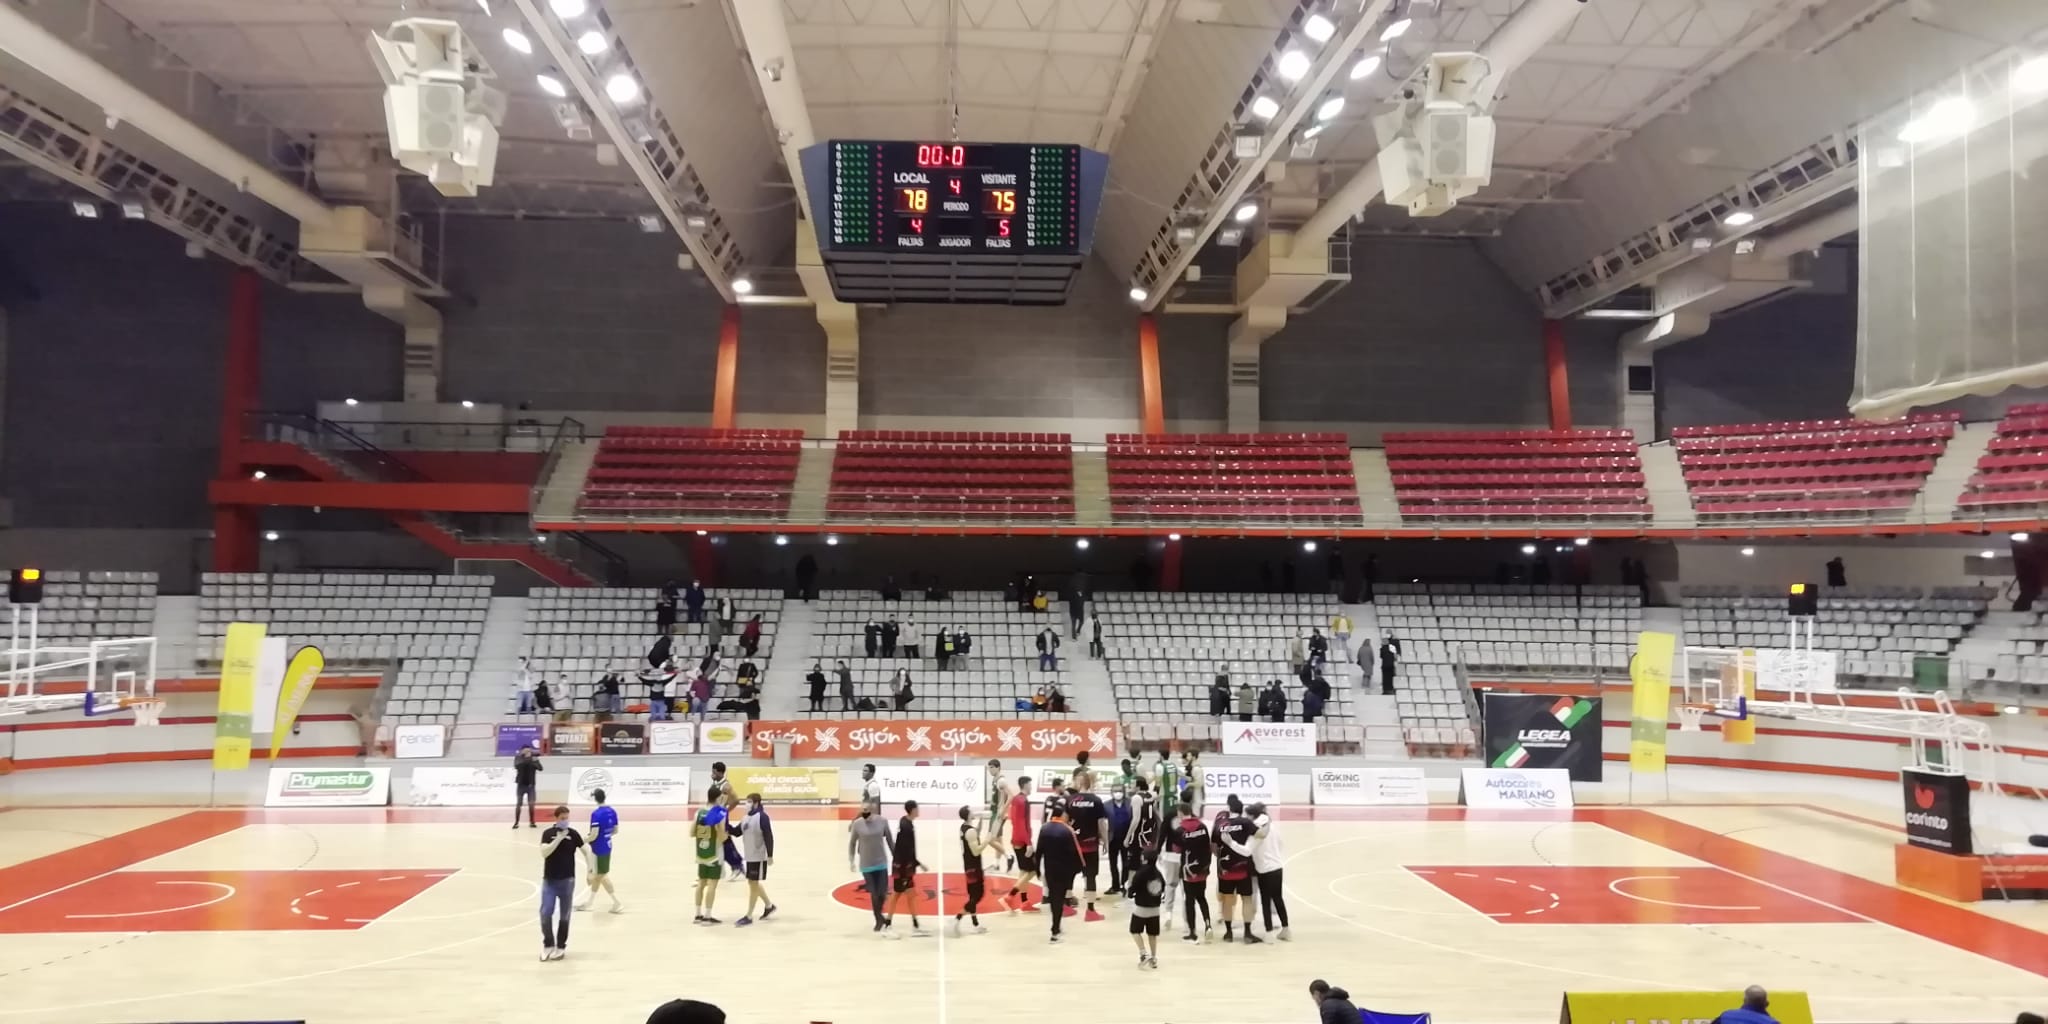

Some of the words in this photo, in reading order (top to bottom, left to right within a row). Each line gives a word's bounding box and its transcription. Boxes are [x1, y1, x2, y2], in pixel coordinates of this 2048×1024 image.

[894, 172, 930, 184] LOCAL
[981, 174, 1016, 185] VISITANTE
[950, 179, 960, 194] 4
[904, 189, 927, 210] 78
[992, 191, 1015, 212] 75
[912, 219, 922, 234] 4
[1000, 219, 1010, 236] 5
[898, 237, 924, 246] FALTAS
[939, 238, 972, 247] JUGADOR
[986, 239, 1011, 248] FALTAS
[849, 727, 900, 751] gijón
[940, 727, 992, 751] gijón
[1030, 727, 1082, 751] gijón
[1255, 728, 1305, 737] everest
[1518, 729, 1571, 741] LEGEA
[289, 772, 369, 789] Prymastur
[883, 778, 928, 788] Tartiere
[930, 779, 959, 790] Auto
[1205, 774, 1265, 788] SEPRO
[1499, 789, 1555, 799] MARIANO
